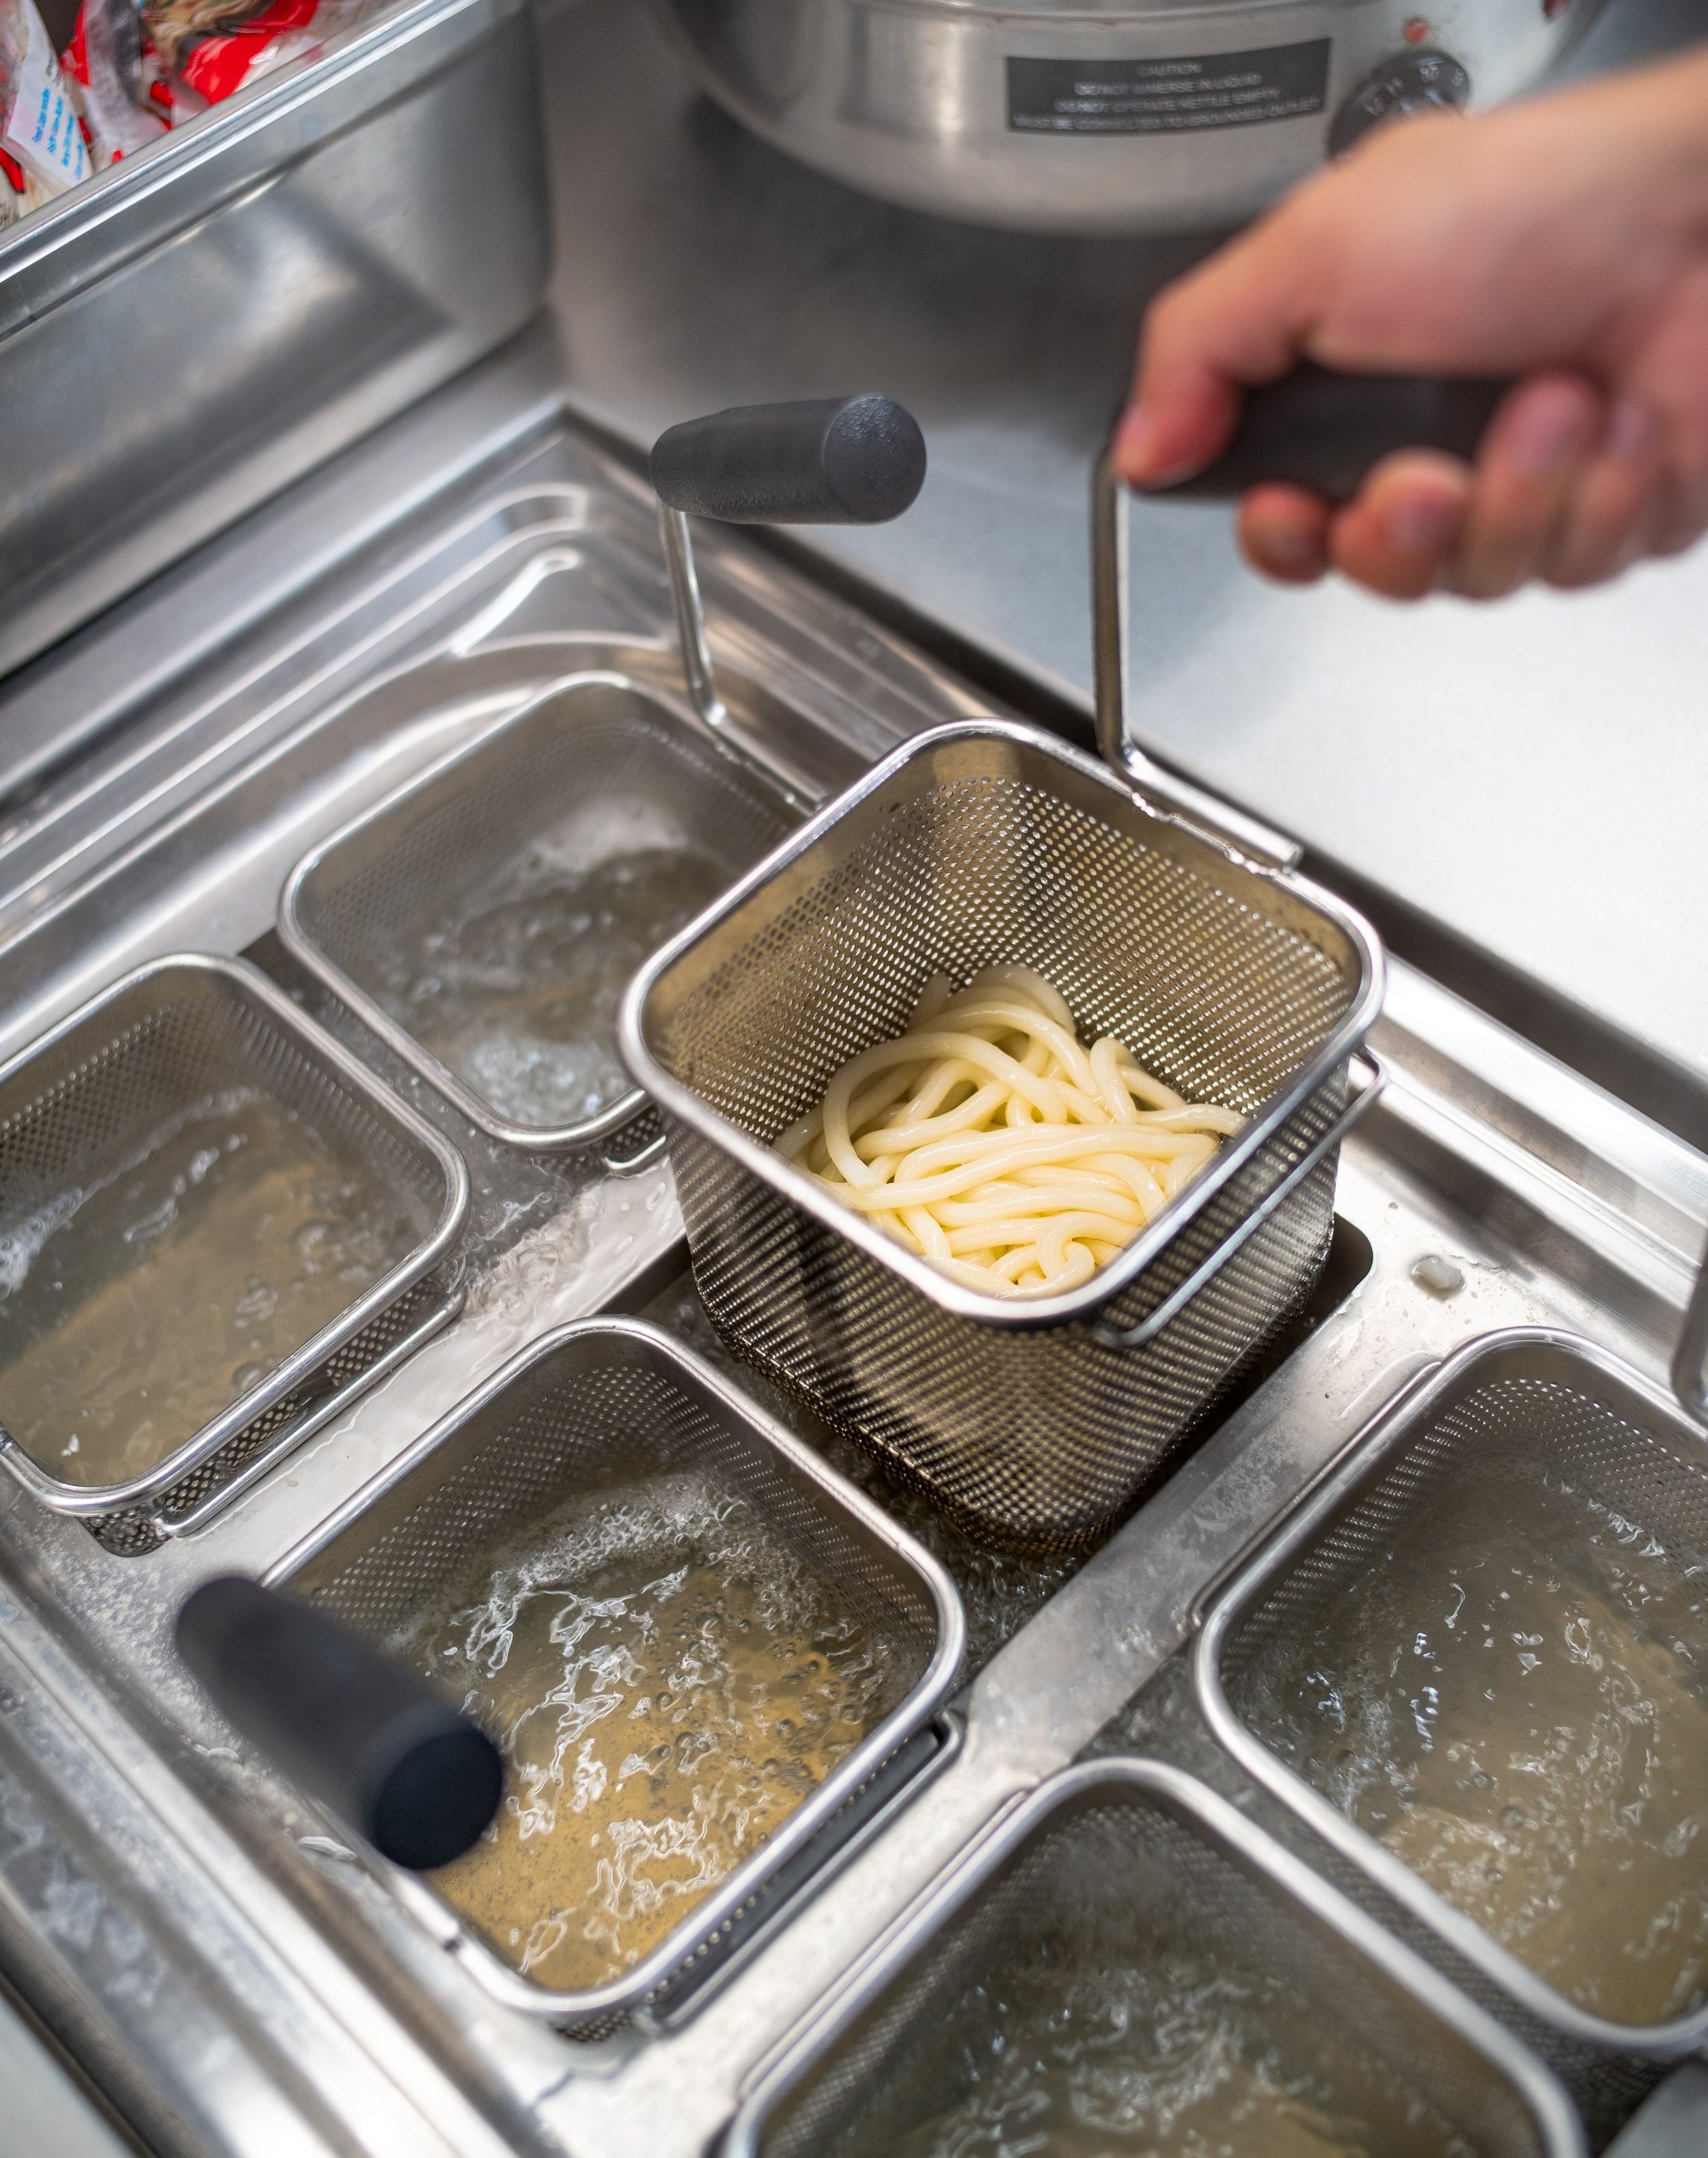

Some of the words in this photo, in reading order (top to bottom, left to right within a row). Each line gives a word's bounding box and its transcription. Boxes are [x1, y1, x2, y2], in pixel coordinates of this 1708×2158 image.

[1138, 62, 1202, 77] CAUTION
[1131, 78, 1197, 95] IMMERSE
[1215, 72, 1263, 89] LIQUID
